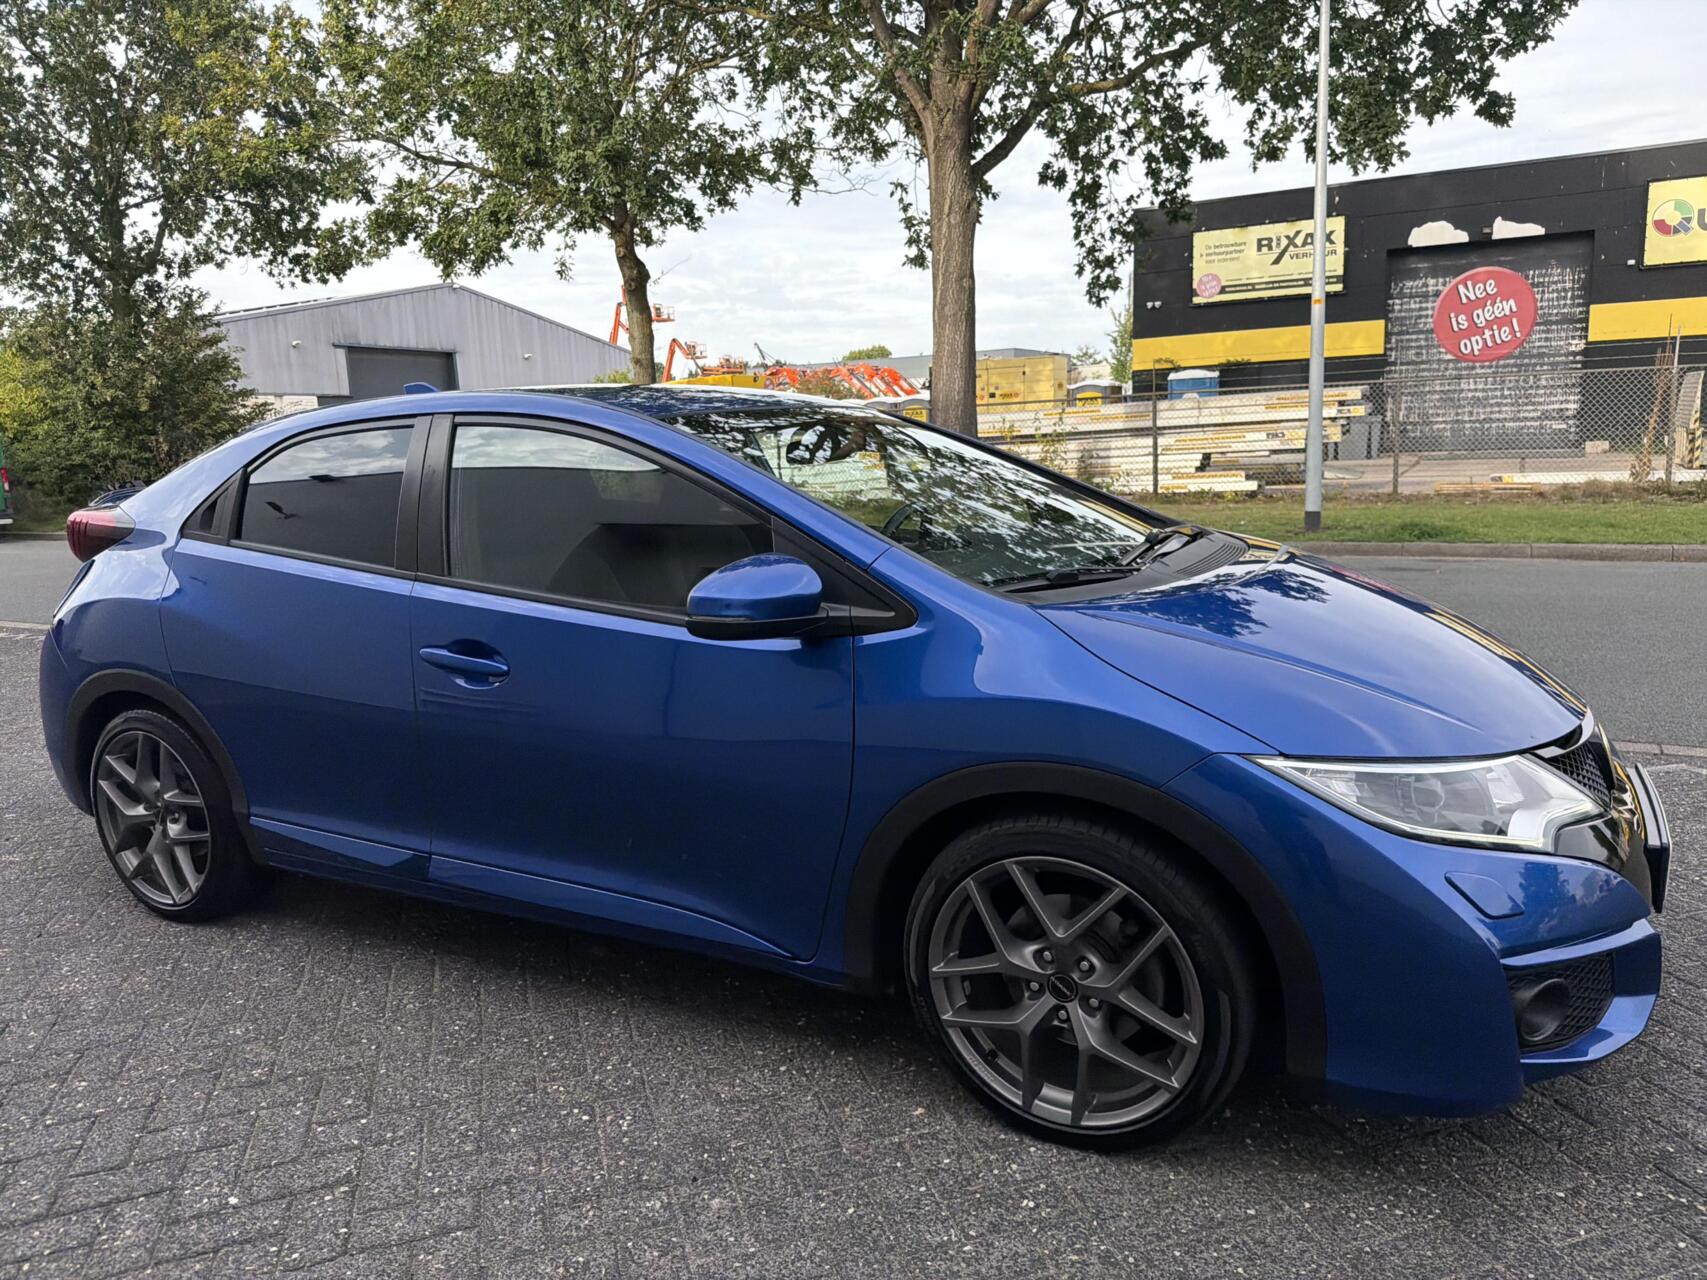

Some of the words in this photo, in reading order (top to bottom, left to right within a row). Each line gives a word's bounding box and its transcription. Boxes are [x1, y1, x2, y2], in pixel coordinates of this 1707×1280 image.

[1457, 279, 1498, 304] Nee
[1449, 312, 1468, 332] is
[1473, 296, 1517, 327] géén
